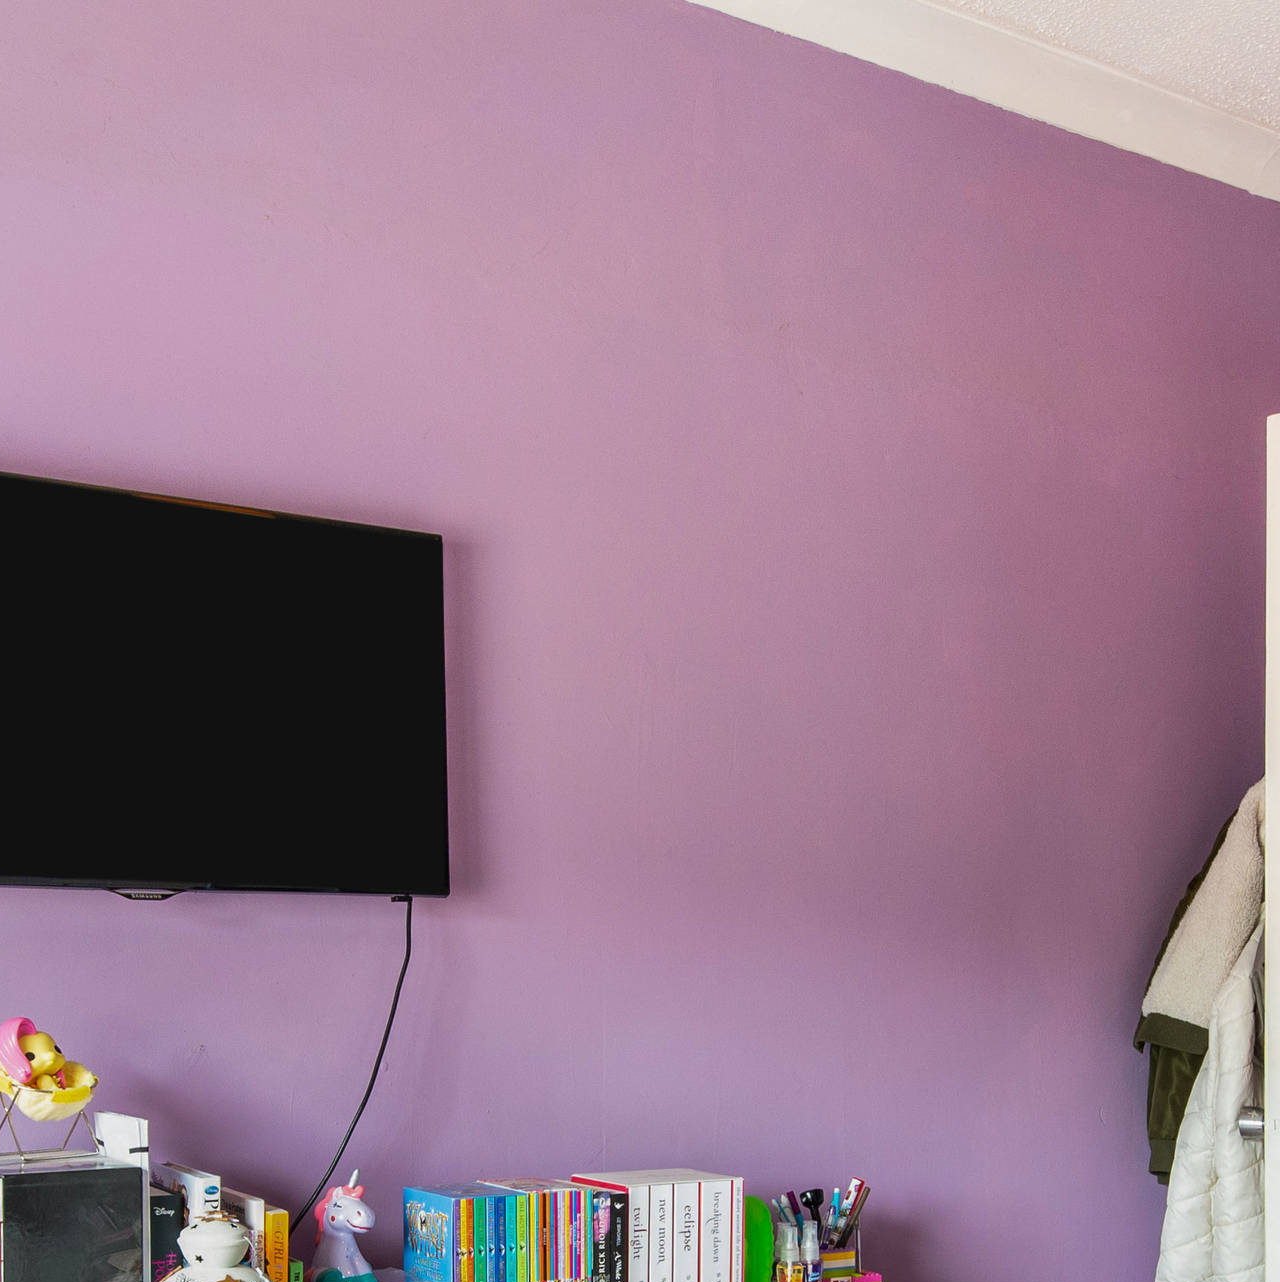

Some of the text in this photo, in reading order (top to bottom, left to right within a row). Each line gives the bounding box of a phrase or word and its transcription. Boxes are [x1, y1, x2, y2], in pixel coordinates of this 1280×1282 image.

[273, 1231, 284, 1263] GIRL
[630, 1207, 647, 1259] twilight
[657, 1199, 666, 1264] new moon
[678, 1205, 696, 1251] eclipse
[706, 1192, 722, 1263] breaking dawn
